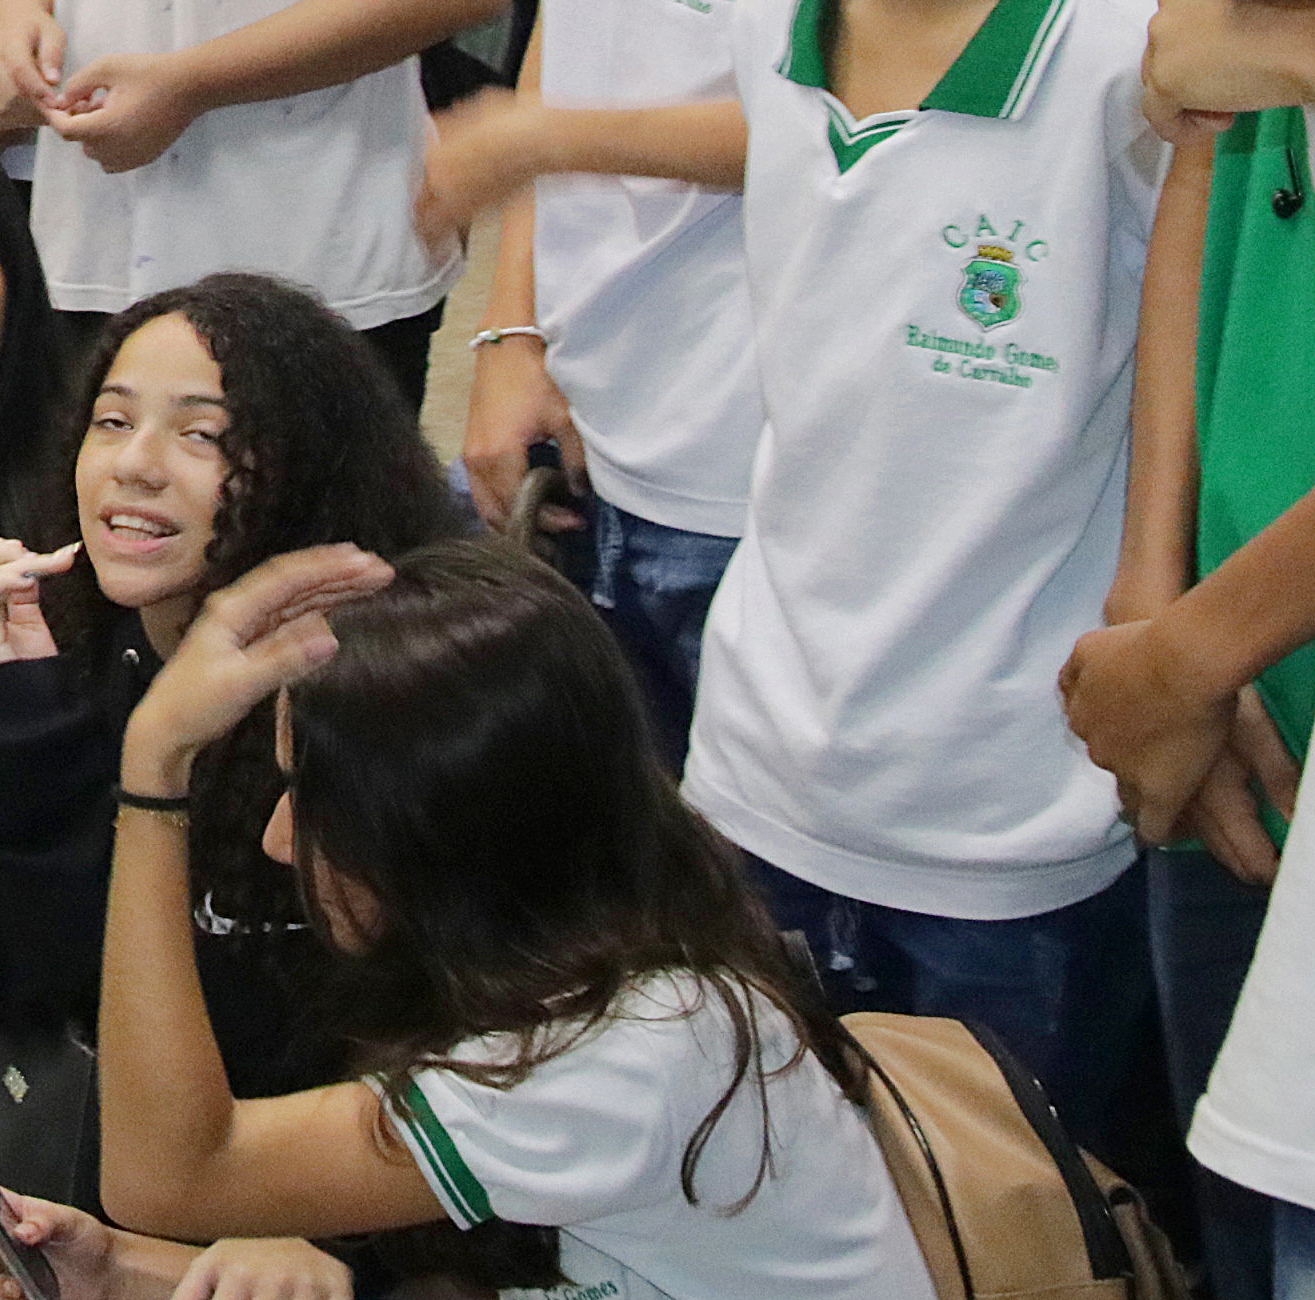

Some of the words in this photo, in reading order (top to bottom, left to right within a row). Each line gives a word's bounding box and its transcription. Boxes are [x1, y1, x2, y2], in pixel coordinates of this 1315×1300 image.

[941, 214, 1049, 262] CAIC
[907, 324, 996, 360] Raimundo
[932, 355, 951, 374] de
